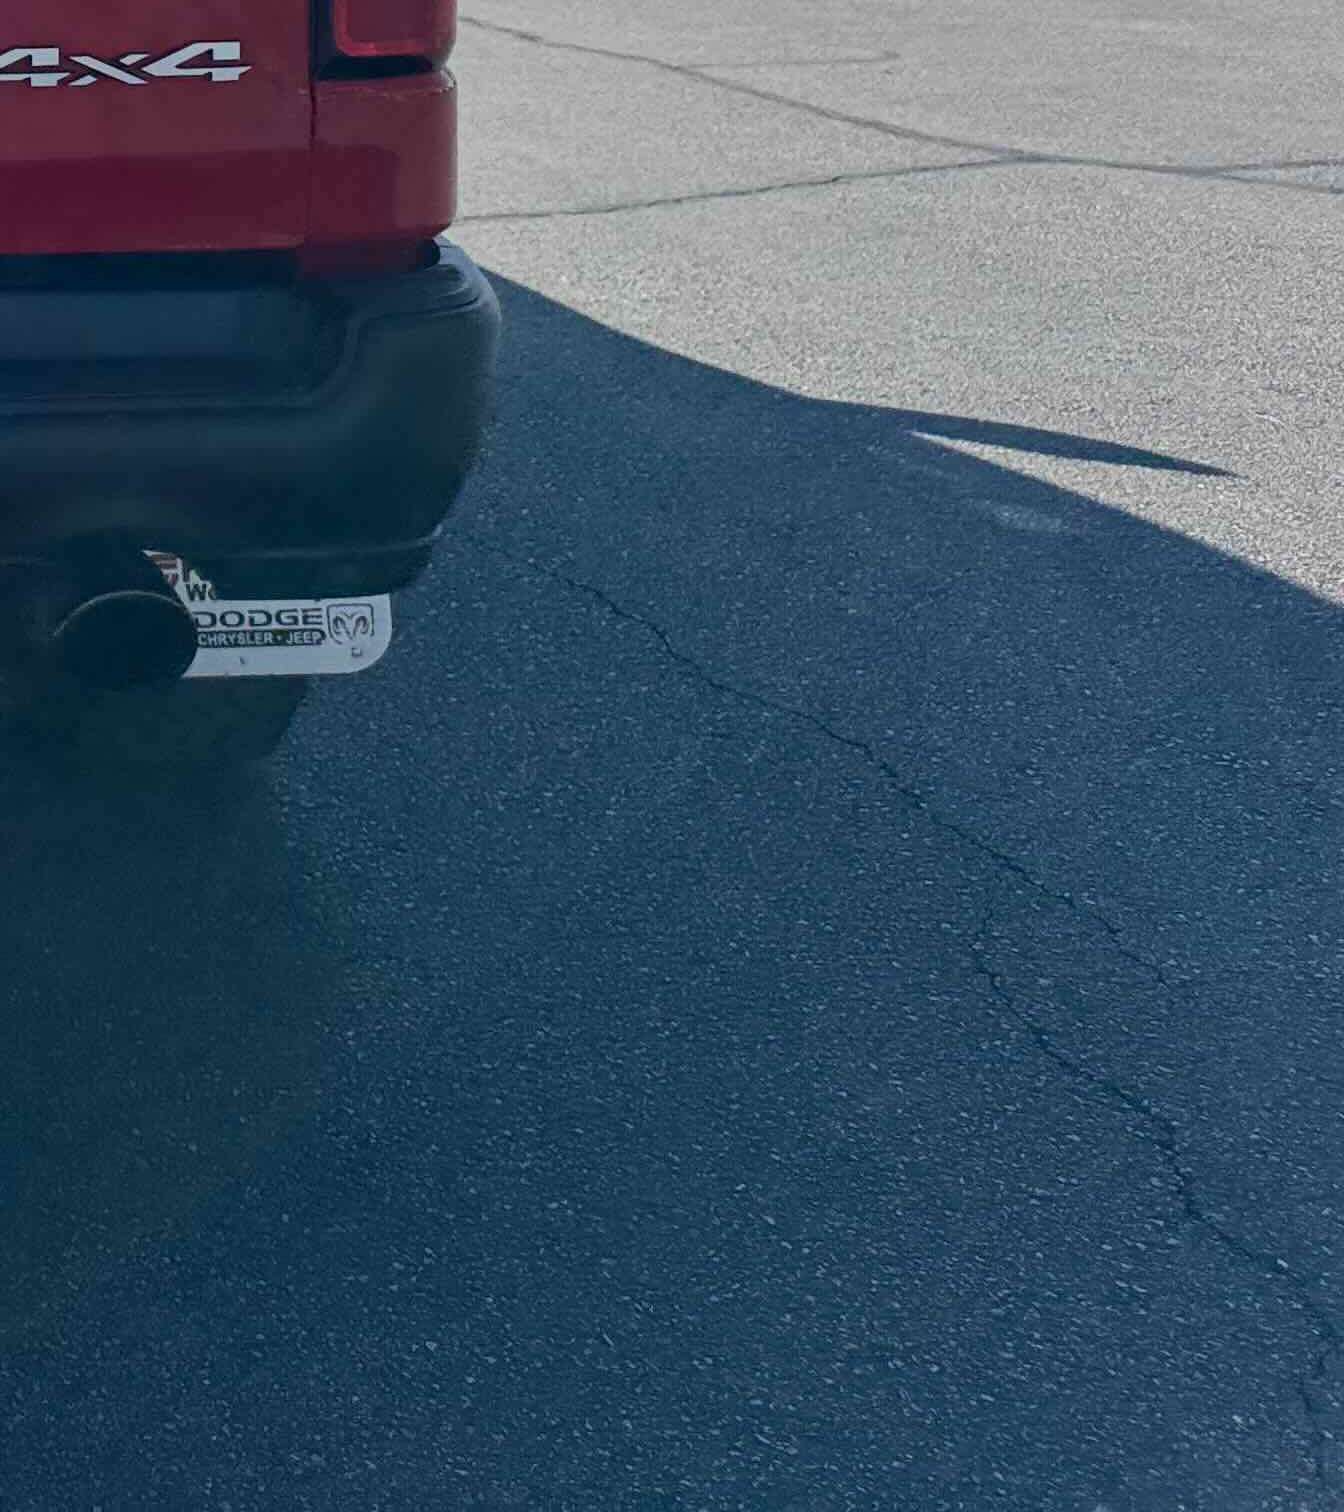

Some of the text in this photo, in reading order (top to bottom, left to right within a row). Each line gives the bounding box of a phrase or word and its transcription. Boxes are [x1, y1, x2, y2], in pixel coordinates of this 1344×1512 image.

[193, 607, 323, 629] DODGE
[197, 630, 323, 647] CHRYSLER JEEP
